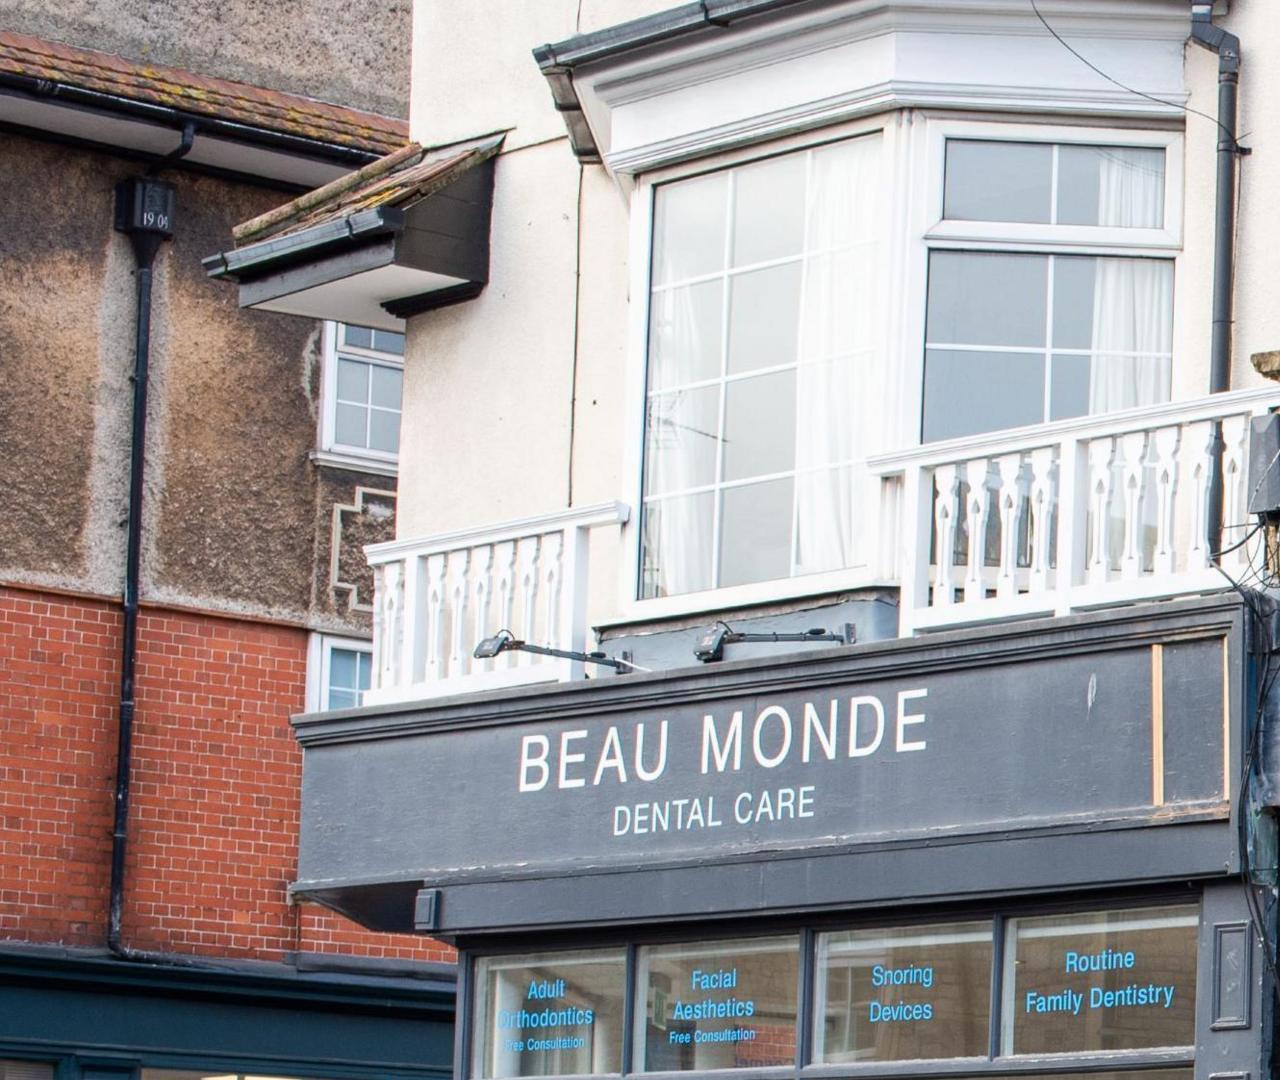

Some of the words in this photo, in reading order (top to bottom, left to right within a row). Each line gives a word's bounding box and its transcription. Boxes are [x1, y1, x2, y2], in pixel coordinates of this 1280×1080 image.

[519, 720, 669, 793] BEAU
[702, 688, 928, 774] MONDE
[613, 795, 723, 836] DENTAL
[734, 786, 815, 825] CARE
[1066, 949, 1134, 973] Routine
[692, 968, 737, 990] Facial
[872, 964, 933, 988] Snoring
[527, 979, 566, 1000] Adult
[1026, 991, 1083, 1015] Family
[1090, 983, 1174, 1008] Dentistry
[498, 1006, 593, 1029] Orthodontics
[674, 998, 755, 1020] Aesthetics
[869, 1001, 933, 1022] Devices
[505, 1039, 524, 1051] Free
[527, 1036, 585, 1050] Consultation
[669, 1030, 691, 1045] Free
[694, 1028, 756, 1043] Consultation
